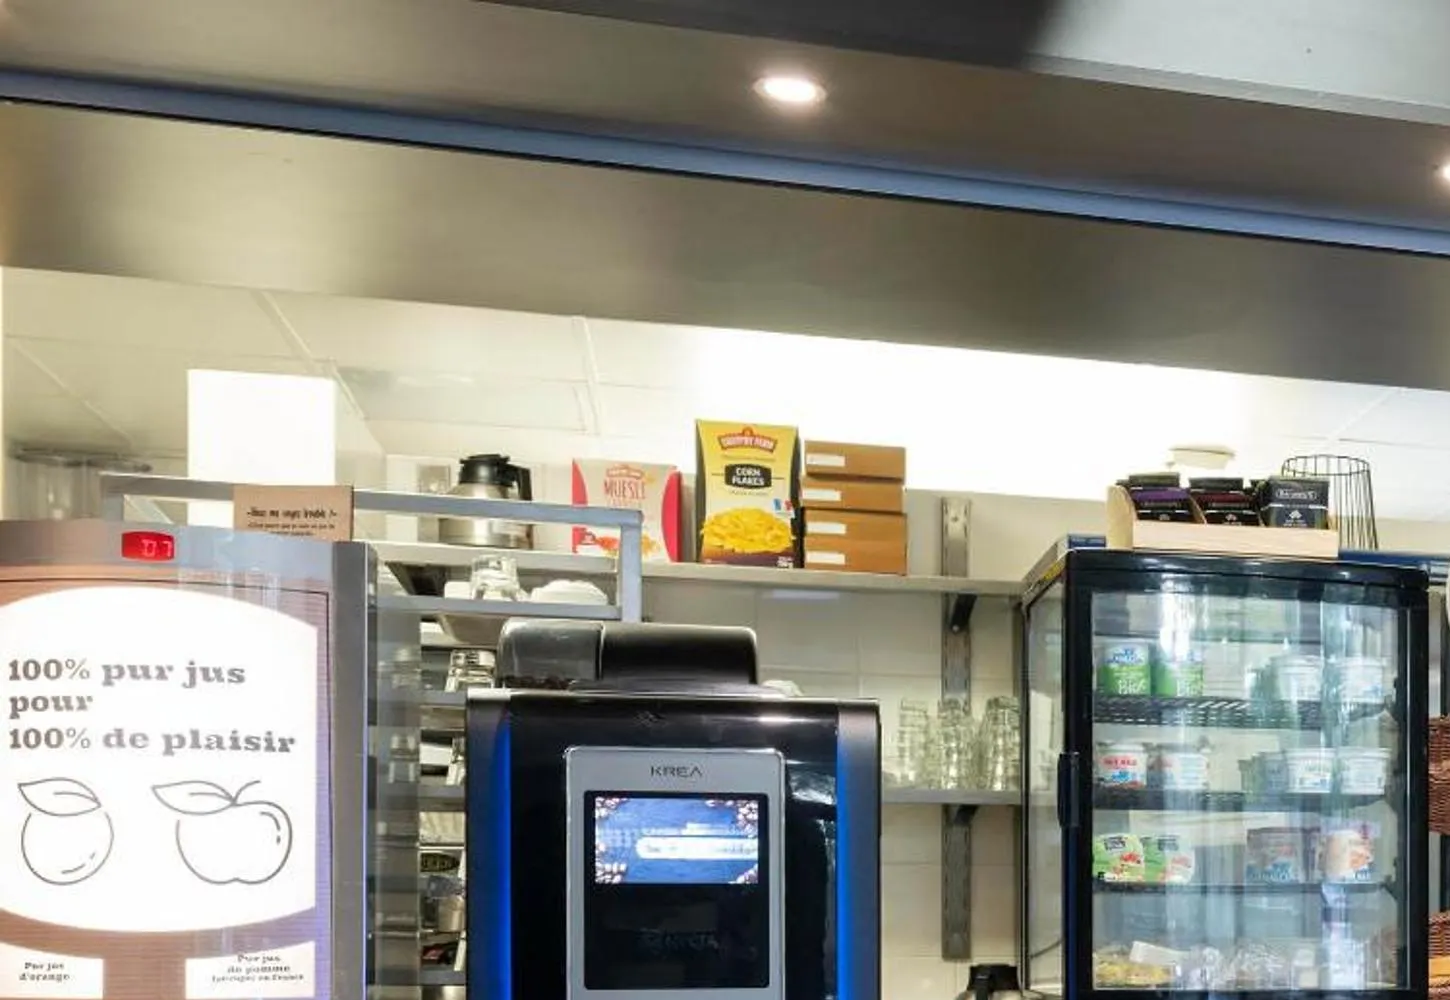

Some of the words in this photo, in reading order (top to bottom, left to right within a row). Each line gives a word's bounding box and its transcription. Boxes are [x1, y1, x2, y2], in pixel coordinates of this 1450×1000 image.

[736, 467, 761, 477] CORN
[732, 476, 765, 486] FLAKES
[9, 659, 90, 681] 100%
[102, 664, 174, 686] pur
[182, 661, 246, 688] jus
[9, 695, 93, 719] pour
[9, 728, 91, 749] 100%
[103, 729, 149, 748] de
[162, 729, 296, 756] plaisir
[651, 766, 702, 777] KREA
